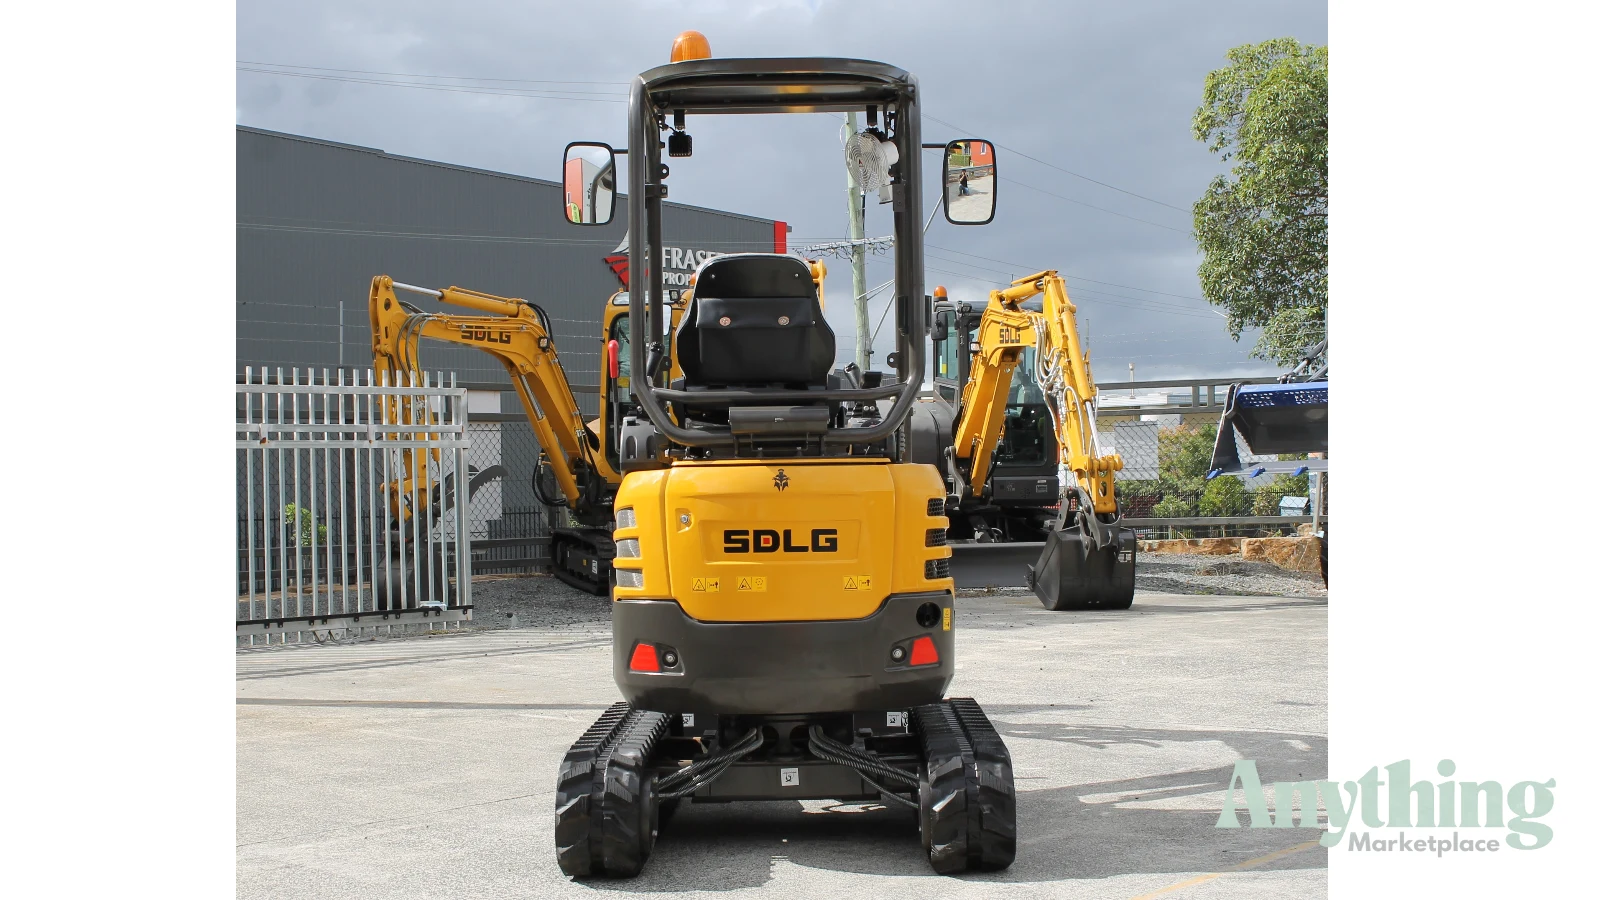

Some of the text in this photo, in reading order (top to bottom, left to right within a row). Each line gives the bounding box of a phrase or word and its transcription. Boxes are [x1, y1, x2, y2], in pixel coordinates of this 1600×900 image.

[460, 325, 511, 344] SDLG
[999, 327, 1021, 344] SDLG
[723, 528, 838, 553] SDLG
